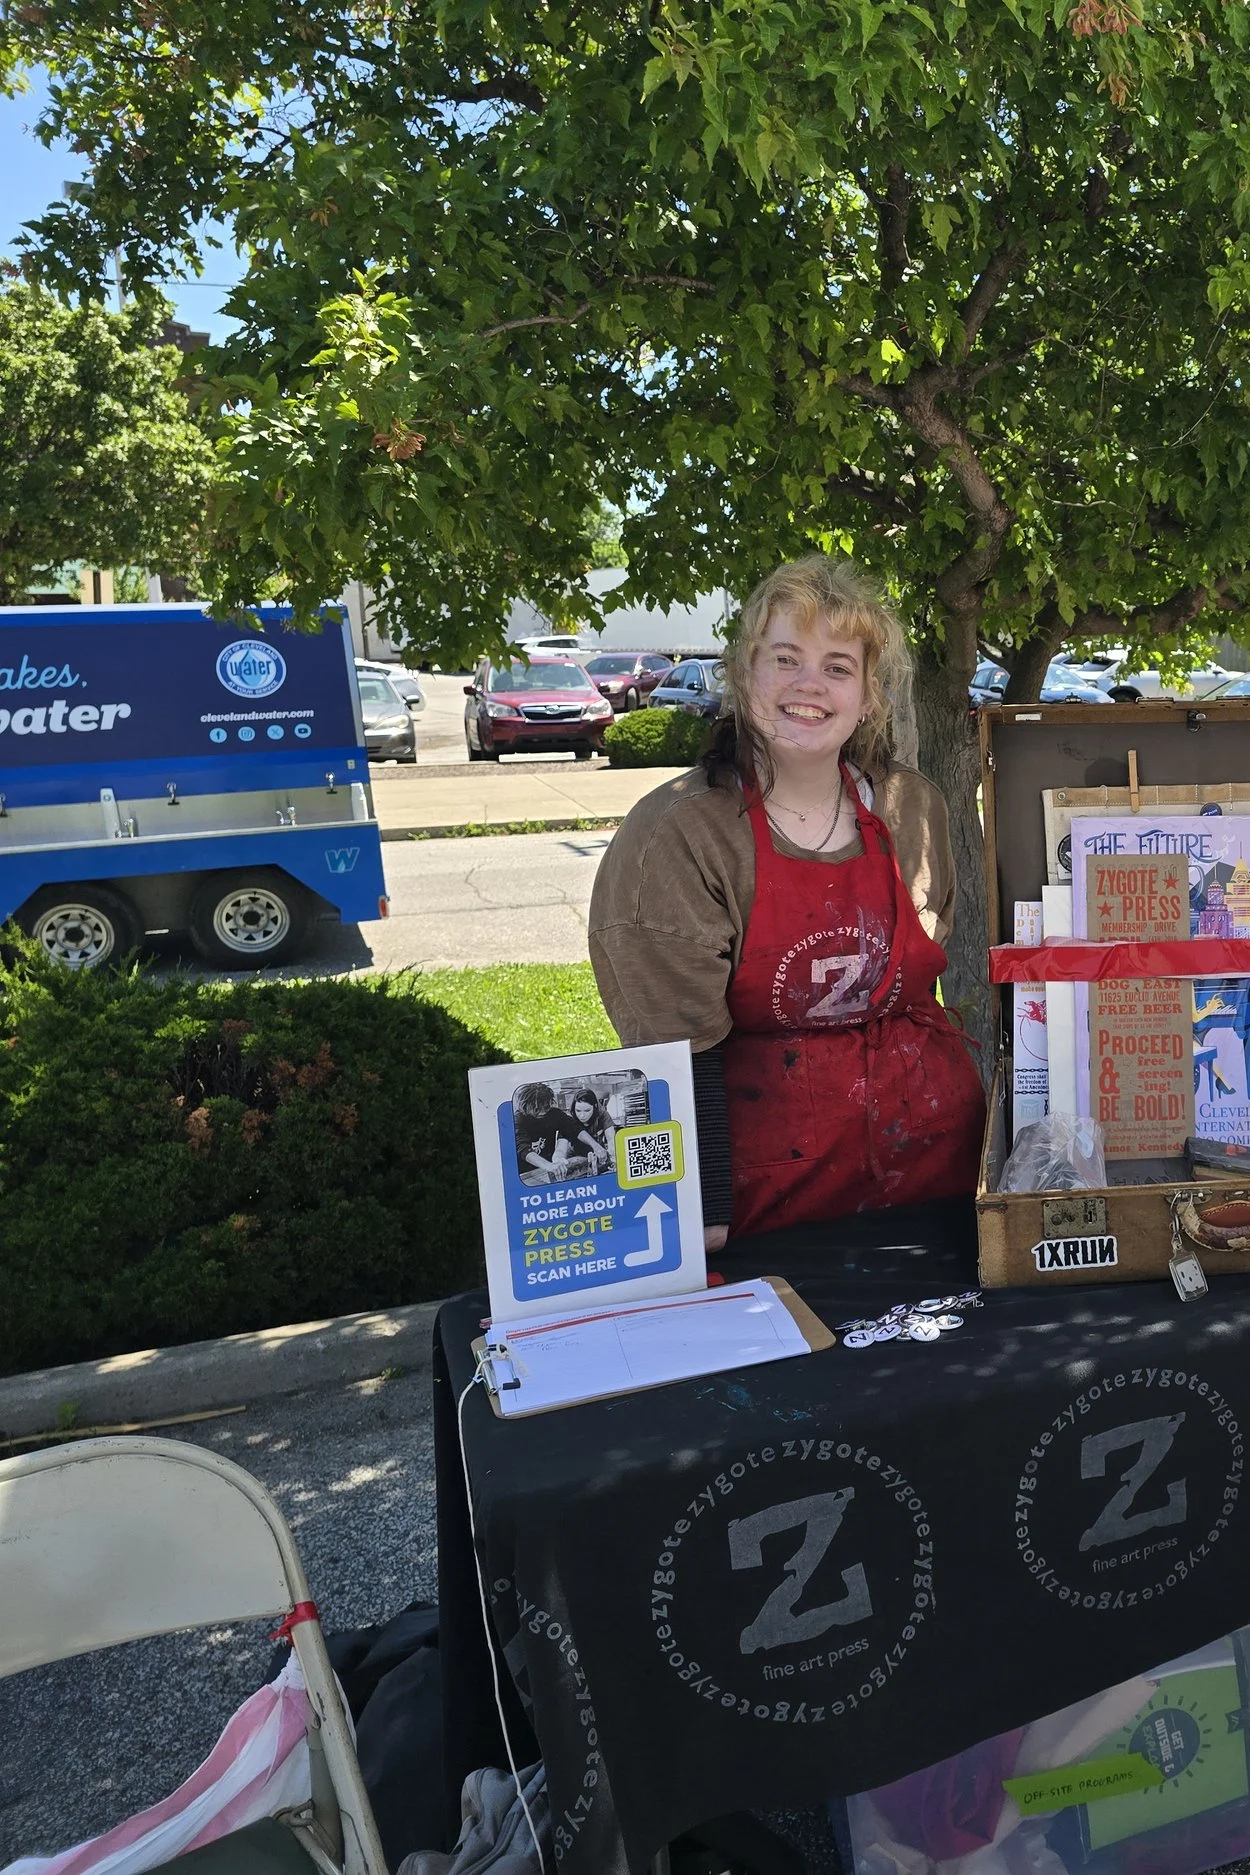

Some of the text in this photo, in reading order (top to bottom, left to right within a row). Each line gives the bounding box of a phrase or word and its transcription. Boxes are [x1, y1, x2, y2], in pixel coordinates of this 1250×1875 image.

[229, 659, 272, 676] water
[200, 709, 315, 722] clevelandwater.com
[1135, 829, 1222, 862] FUTURE
[1096, 869, 1158, 896] ZYGOTE
[1016, 904, 1040, 917] The
[1122, 896, 1181, 921] PRESS
[1101, 922, 1177, 932] MEMBERSHIP DRIVE
[1098, 979, 1182, 990] DOG EAST
[1100, 991, 1179, 1003] 11625 EUCLID AVENUE
[1098, 1004, 1182, 1015] FREE BEER
[1099, 1030, 1184, 1060] PROCEED
[1099, 1056, 1166, 1094] & free
[1137, 1070, 1182, 1079] screen
[1099, 1094, 1186, 1122] BE BOLD!
[520, 1184, 598, 1208] TO LEARN
[522, 1196, 626, 1224] MORE ABOUT
[523, 1215, 614, 1246] ZYGOTE
[525, 1239, 596, 1267] PRESS
[1033, 1238, 1115, 1268] 1XRUN
[527, 1257, 617, 1285] SCAN HERE
[1078, 1411, 1187, 1551] Z
[1092, 1536, 1178, 1573] fine art press
[727, 1486, 874, 1654] Z
[762, 1637, 870, 1681] fine art press
[1154, 1718, 1173, 1762] OUTSIDE
[1171, 1730, 1185, 1750] GET
[1023, 1770, 1134, 1804] OFF-SITE PROGRAMS
